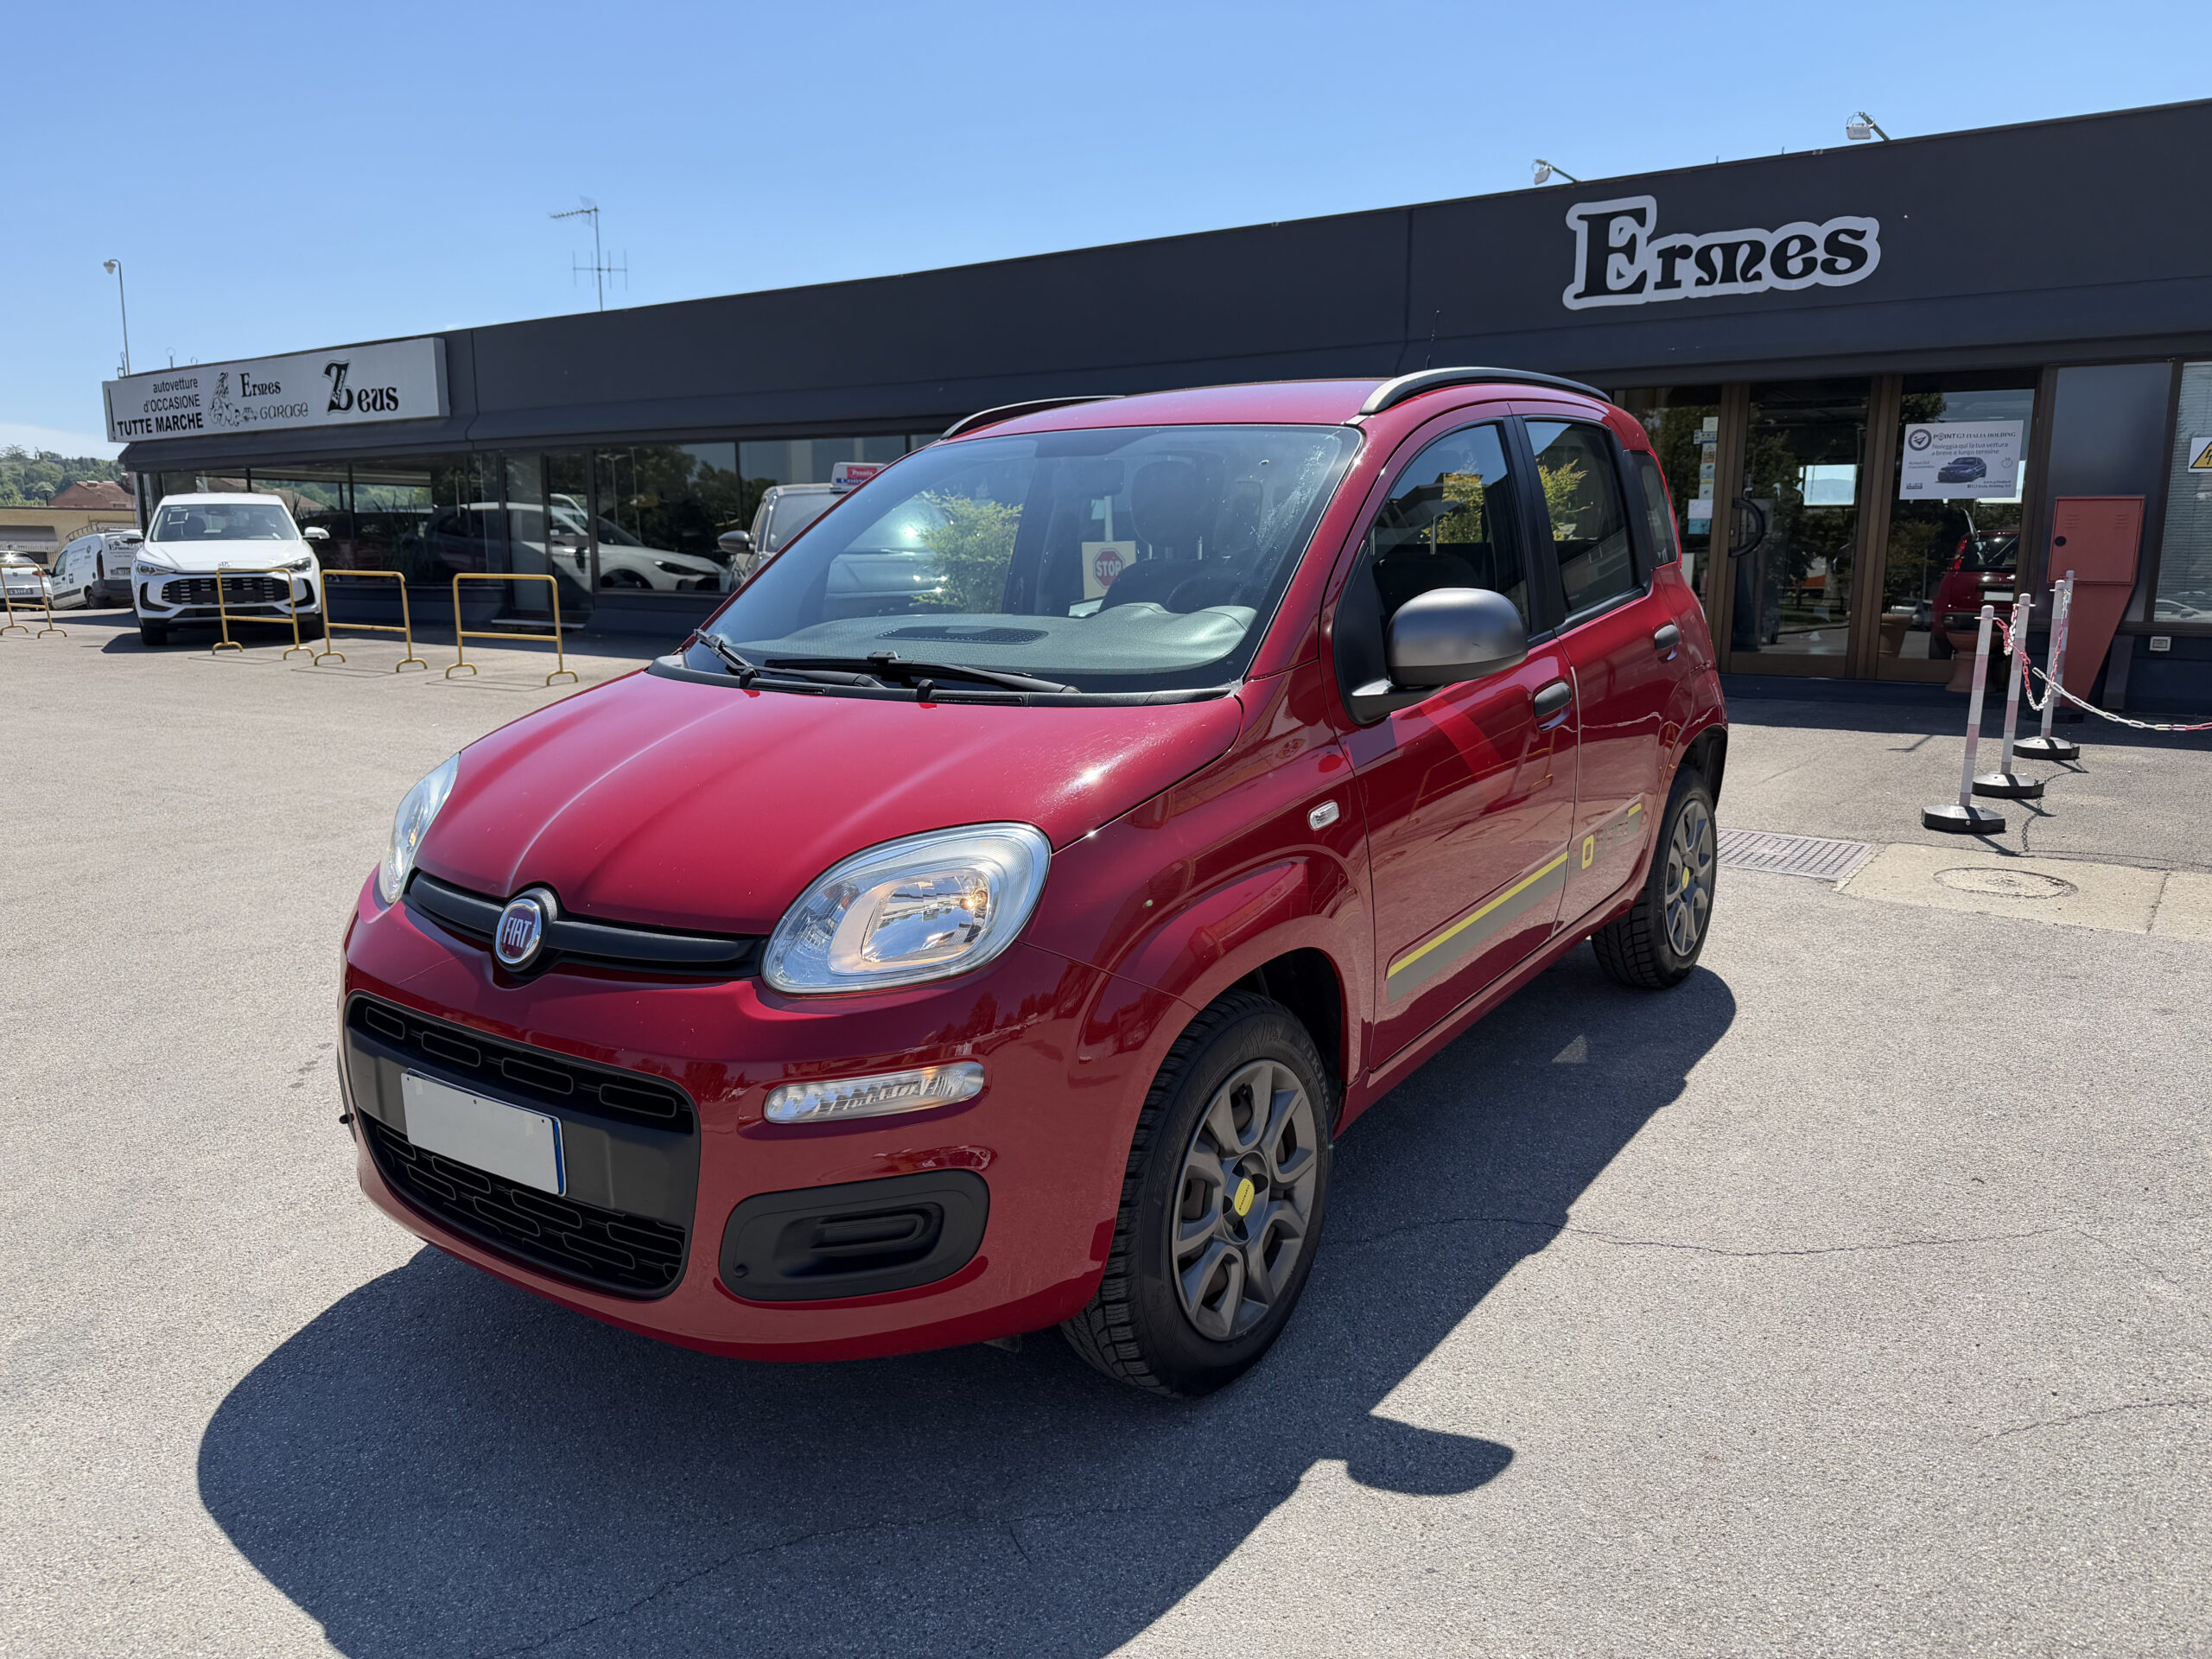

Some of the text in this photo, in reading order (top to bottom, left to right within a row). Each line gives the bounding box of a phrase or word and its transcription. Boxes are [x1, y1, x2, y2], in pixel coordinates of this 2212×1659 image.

[1573, 206, 1869, 300] Ermes
[153, 378, 199, 393] autovetture
[239, 372, 282, 397] Ermes
[323, 361, 399, 414] Zeus
[143, 394, 200, 413] d'OCCASIONE
[118, 412, 204, 436] TUTTE MARCHE
[1096, 560, 1122, 577] STOP
[503, 917, 532, 948] FIAT
[1300, 1036, 1331, 1111] VIKING
